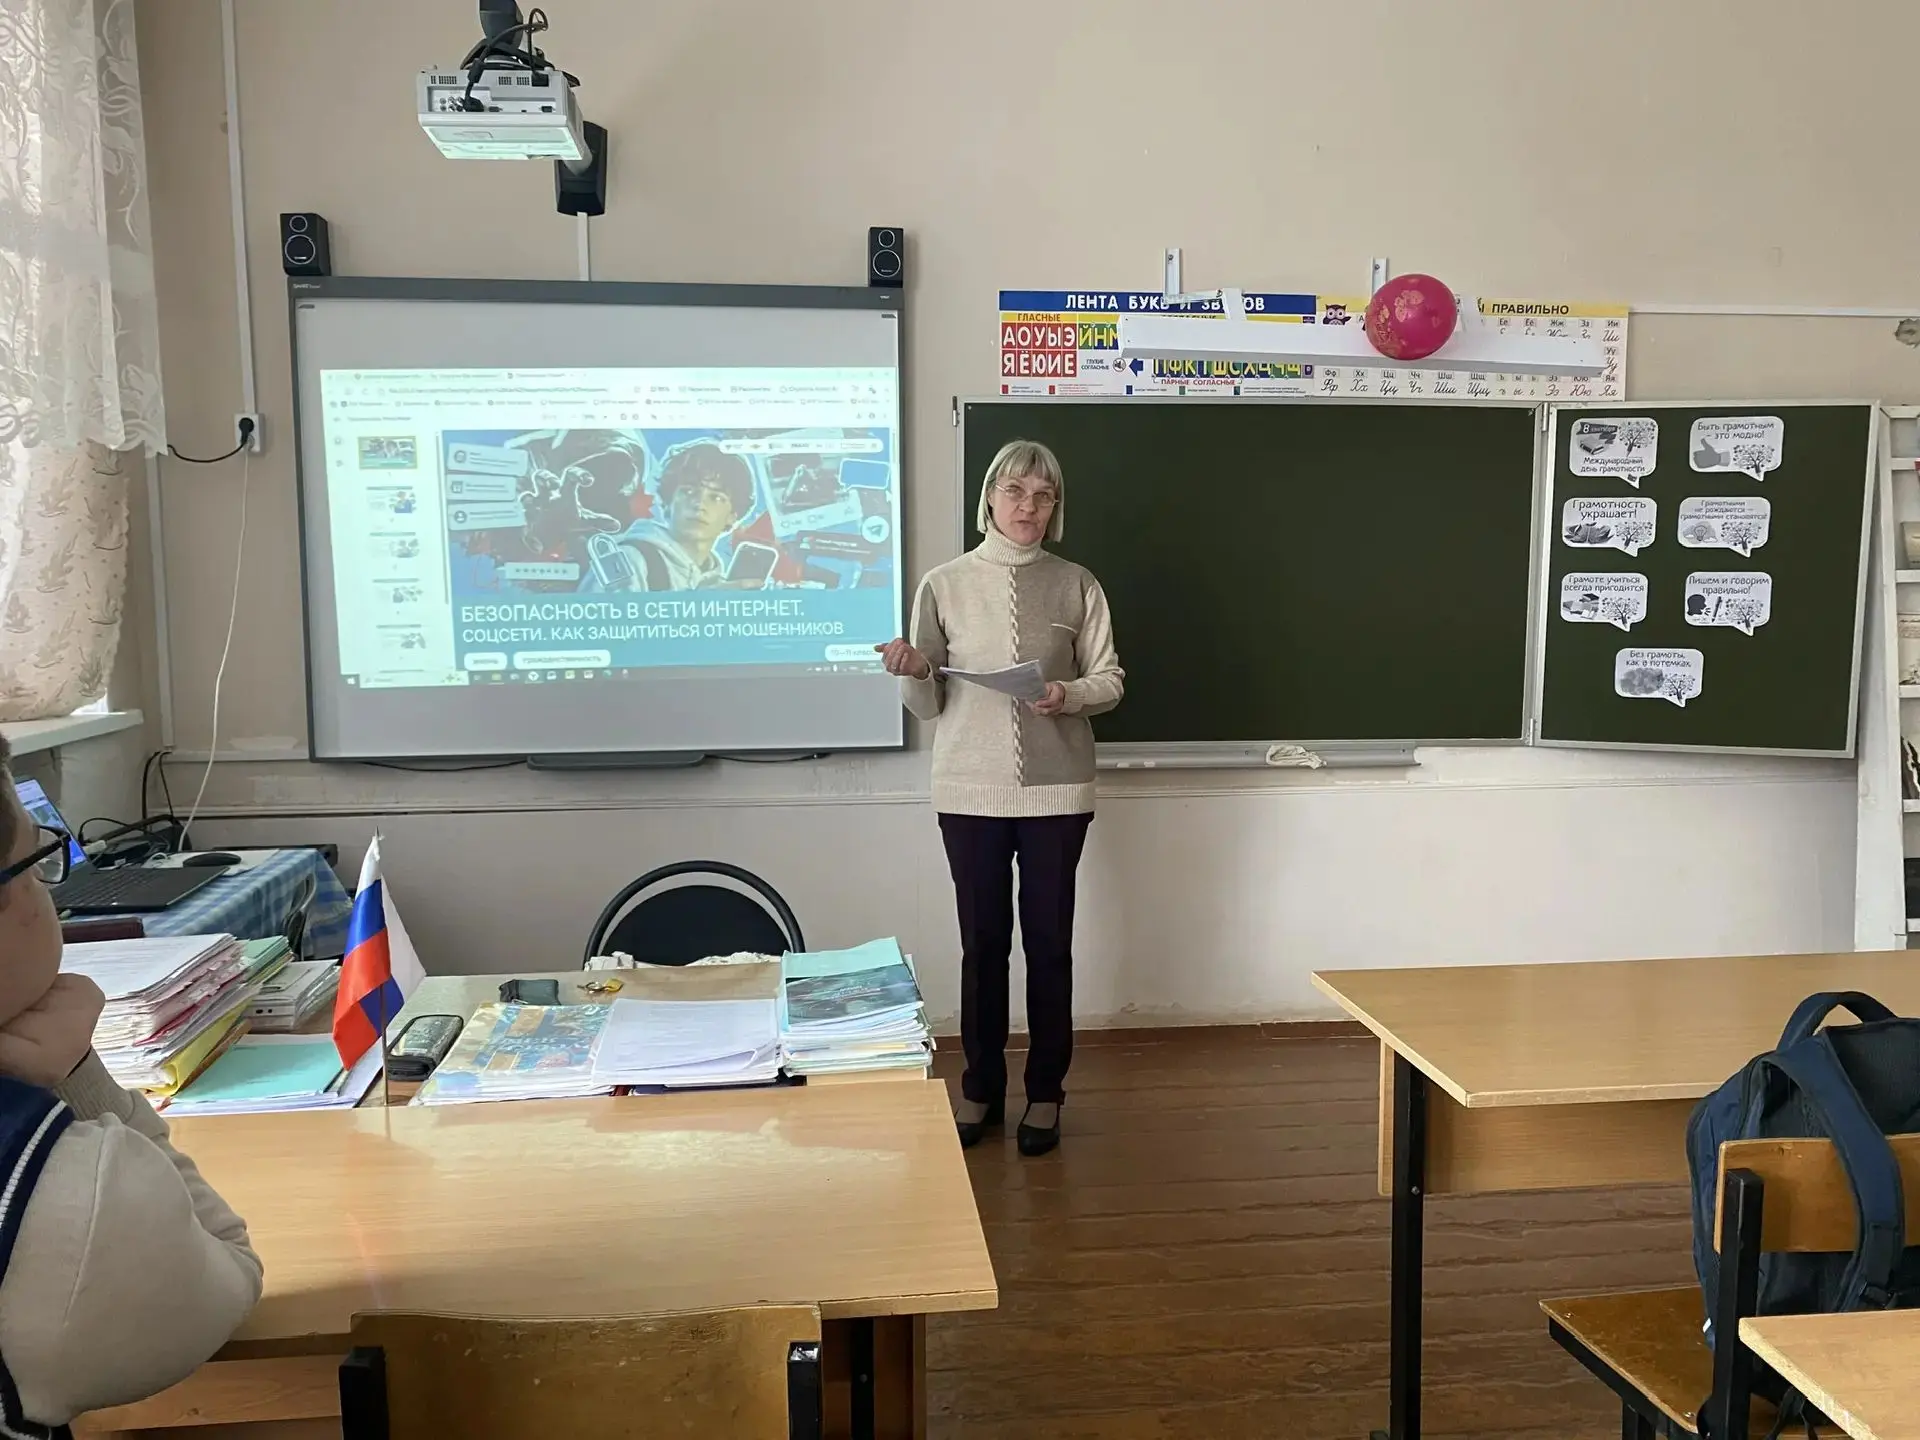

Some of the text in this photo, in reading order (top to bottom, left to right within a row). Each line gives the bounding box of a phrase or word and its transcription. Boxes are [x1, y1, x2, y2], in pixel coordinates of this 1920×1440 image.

[1065, 294, 1119, 309] ЛЕНТА
[1201, 297, 1265, 311] ЗВОВ
[1491, 303, 1570, 316] ПРАВИЛЬНО
[1017, 313, 1061, 321] ГЛАСНЫЕ
[1324, 370, 1337, 378] Фф
[1383, 371, 1395, 380] Цц
[1410, 371, 1421, 379] Чч
[1438, 372, 1452, 380] Шш
[1583, 423, 1590, 434] 8
[1697, 421, 1774, 432] Быть грамотным
[1714, 431, 1730, 440] это
[1732, 430, 1765, 440] модно!
[1583, 457, 1643, 466] Международный
[1599, 465, 1646, 474] грамотности
[1572, 500, 1647, 511] Грамотность
[1580, 509, 1637, 521] украшает!
[1568, 575, 1641, 585] Грамоте учиться
[1688, 576, 1720, 584] Пишем
[1730, 577, 1770, 587] говорим
[1564, 584, 1645, 593] всегда пригодится
[1702, 586, 1751, 596] правильно!
[461, 599, 805, 623] БЕЗОПАСНОСТЬ В СЕТИ ИНТЕРНЕТ.
[462, 621, 844, 644] СОЦСЕТИ. КАК ЗАЩИТИТЬСЯ ОТ МОШЕННИКОВ
[1629, 650, 1644, 658] Без
